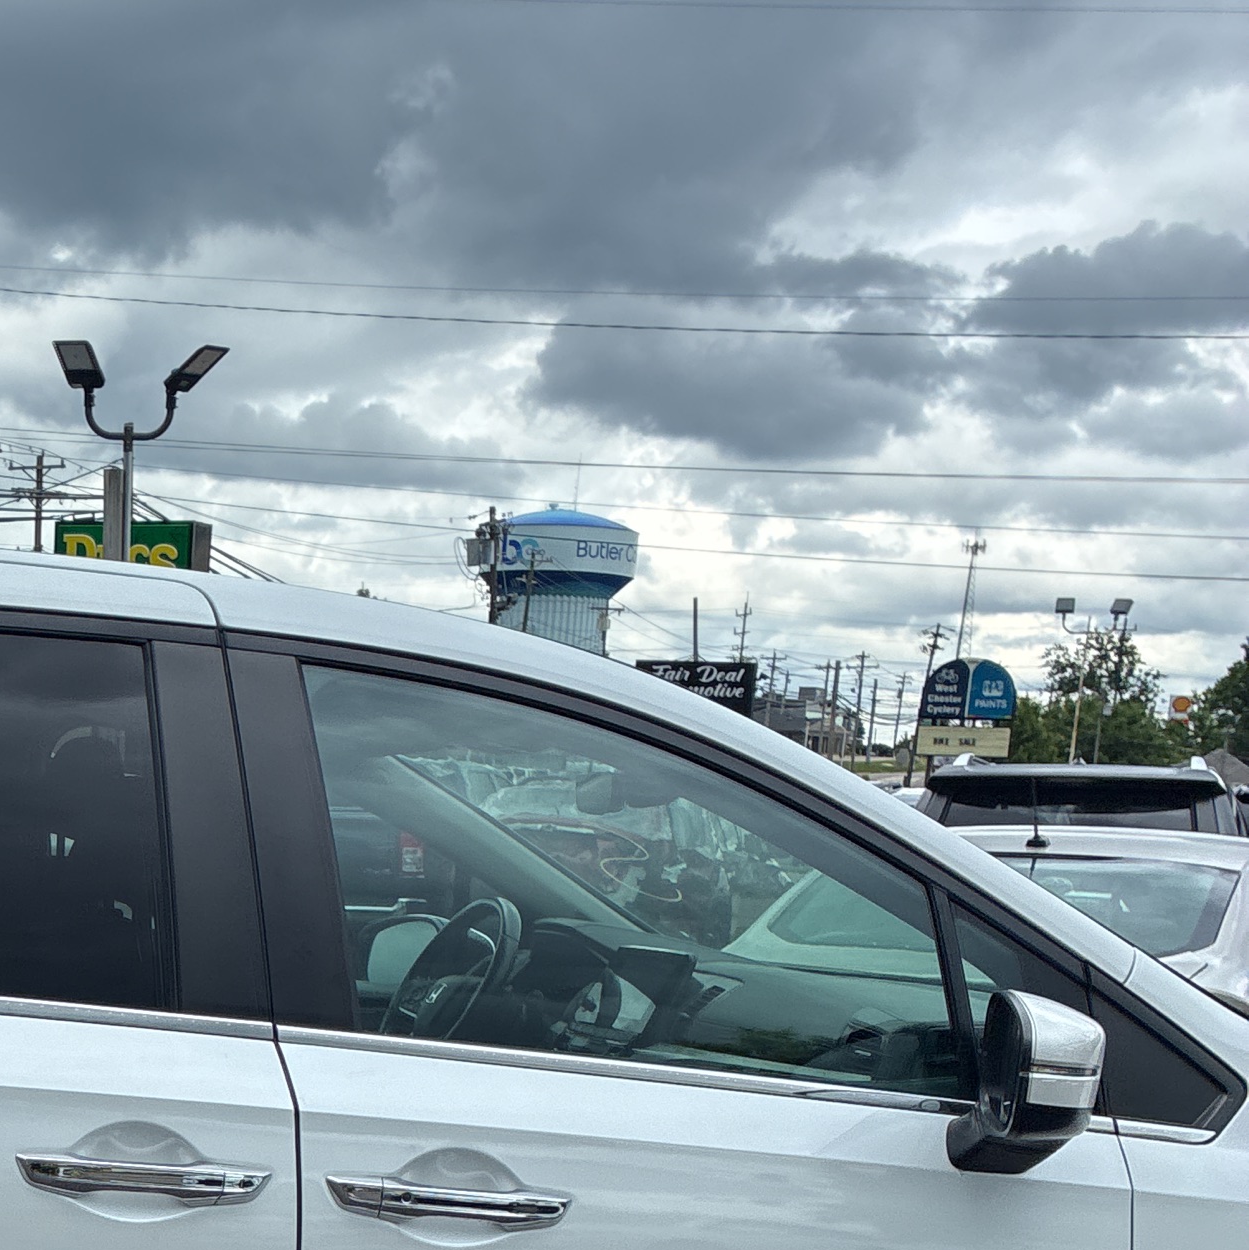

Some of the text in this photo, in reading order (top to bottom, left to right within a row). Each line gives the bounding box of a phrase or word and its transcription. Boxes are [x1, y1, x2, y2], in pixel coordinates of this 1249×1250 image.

[576, 540, 624, 562] Butler
[651, 664, 746, 683] Fair Deal
[935, 683, 958, 693] West
[927, 693, 962, 703] Chester
[974, 698, 1008, 709] PAINTS
[926, 704, 961, 716] Cyclery
